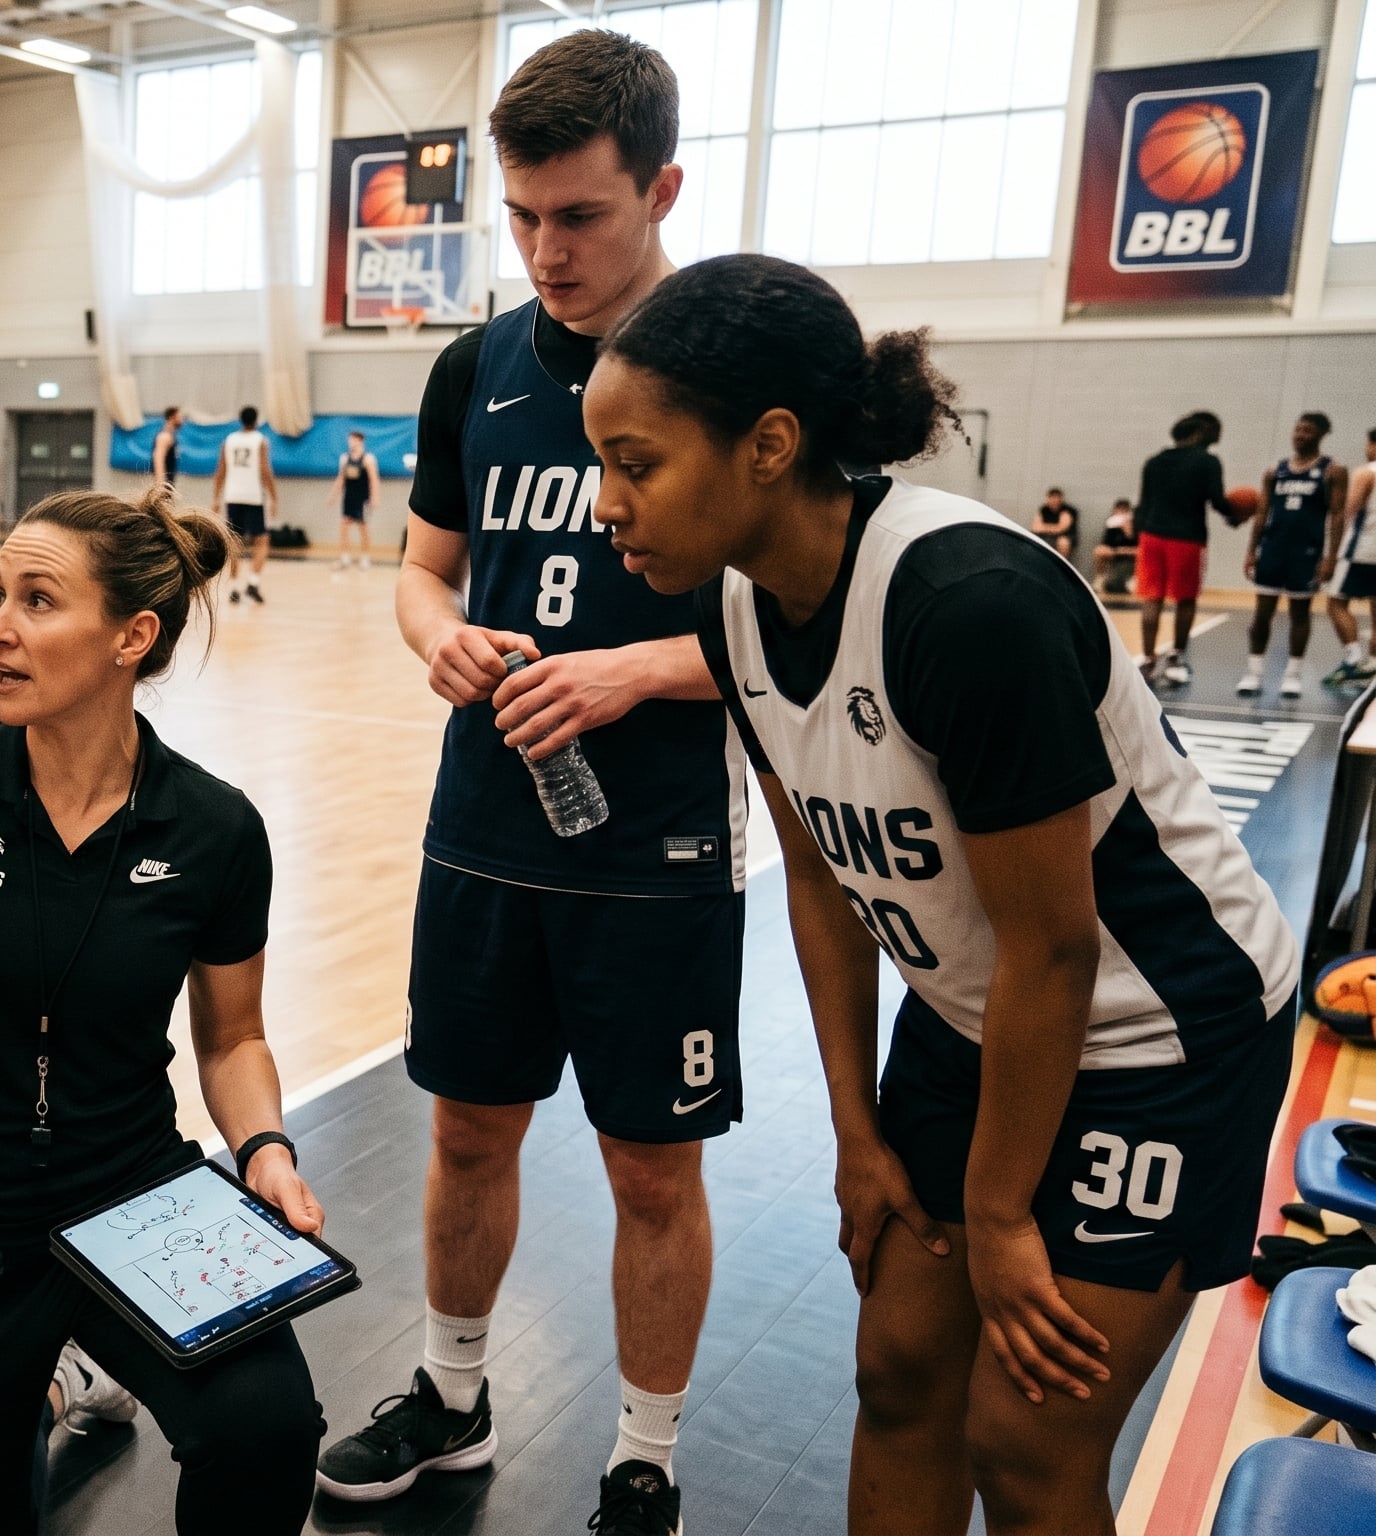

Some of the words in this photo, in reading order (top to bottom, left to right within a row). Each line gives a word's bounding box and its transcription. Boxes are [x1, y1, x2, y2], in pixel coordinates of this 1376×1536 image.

[1124, 207, 1238, 258] BBL
[481, 464, 616, 534] LION
[535, 554, 580, 628] 8
[137, 858, 171, 876] NIKE
[682, 1029, 714, 1088] 8
[1071, 1130, 1184, 1220] 30
